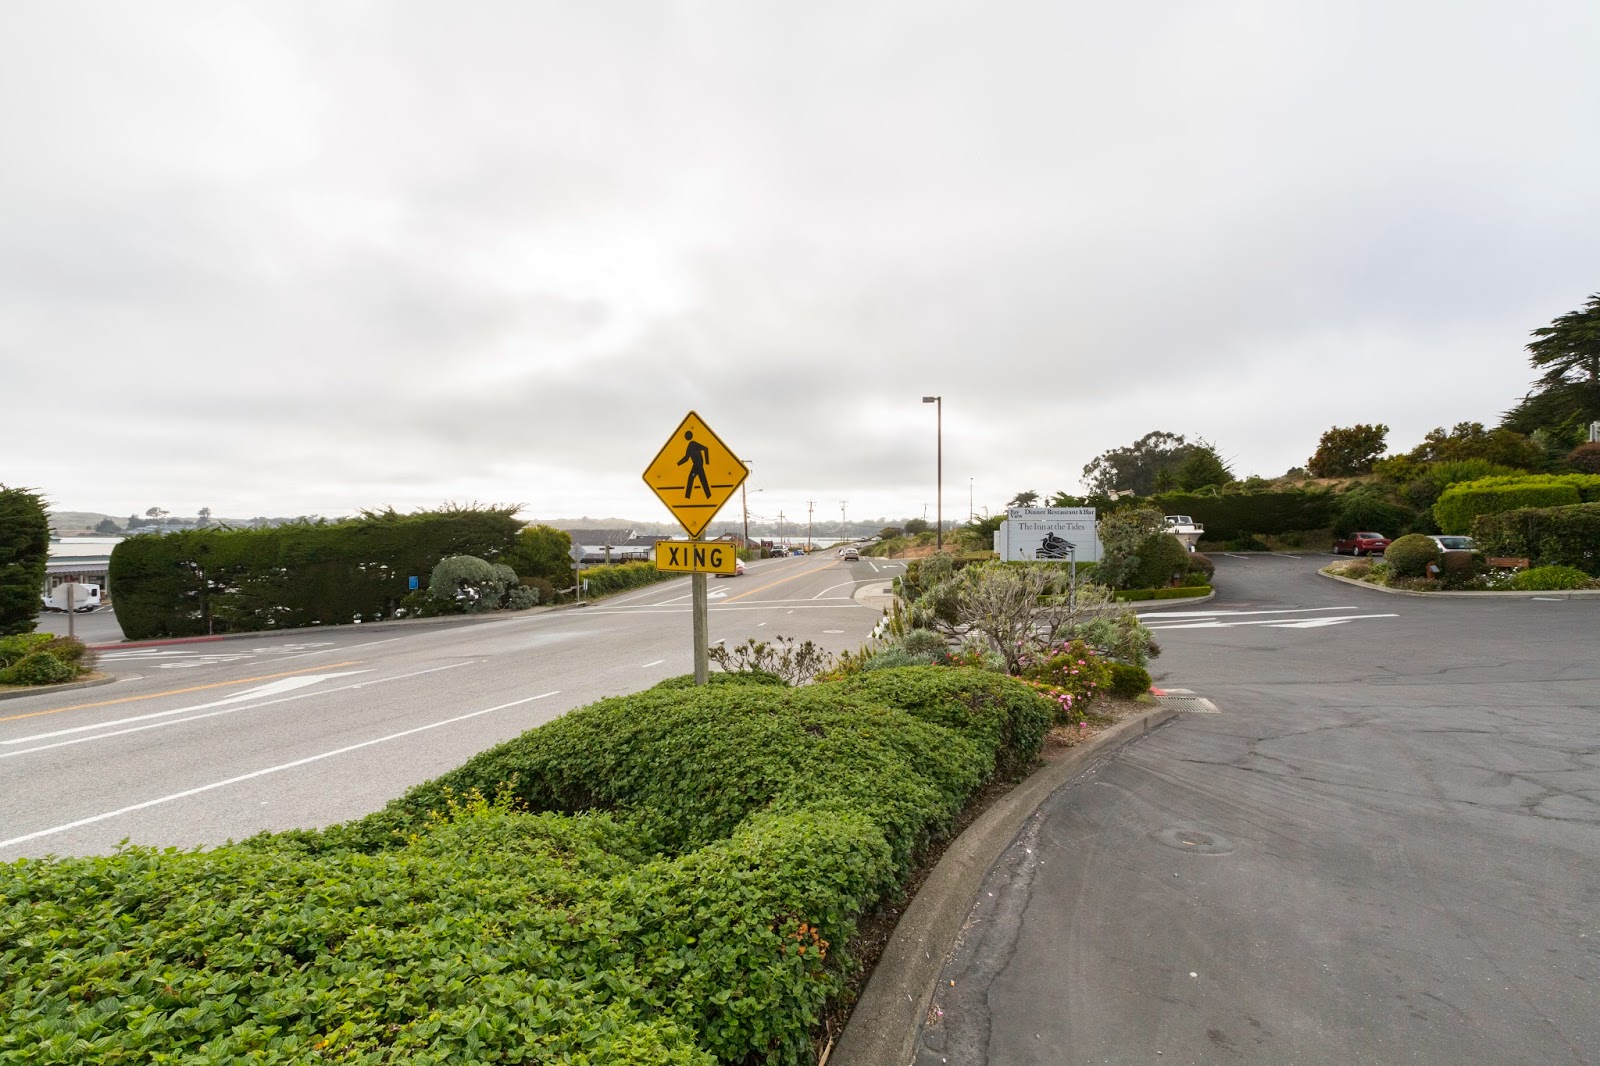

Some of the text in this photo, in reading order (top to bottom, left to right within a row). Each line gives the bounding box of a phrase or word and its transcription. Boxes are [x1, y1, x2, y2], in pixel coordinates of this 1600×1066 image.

[1018, 522, 1033, 531] The
[1034, 522, 1046, 531] Inn
[1054, 522, 1066, 531] the
[1066, 522, 1085, 531] Tides
[669, 547, 722, 568] XING
